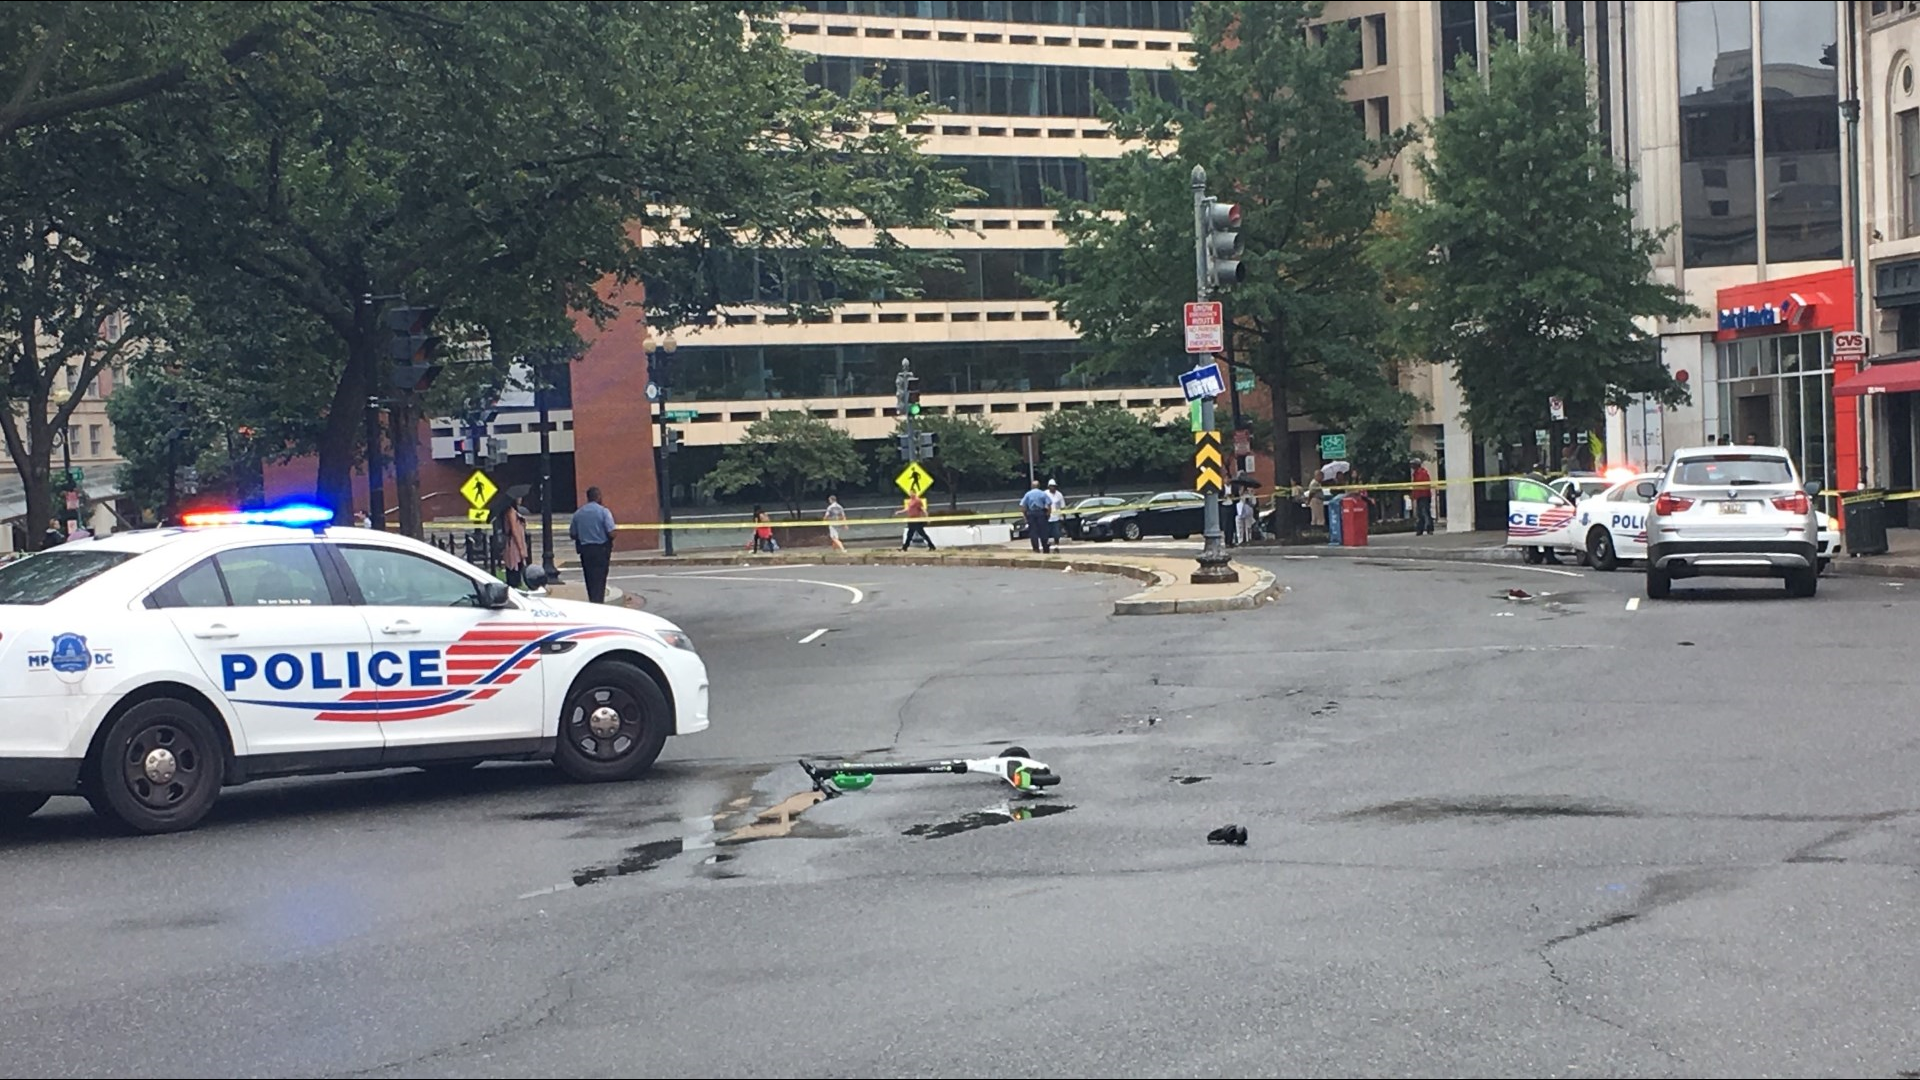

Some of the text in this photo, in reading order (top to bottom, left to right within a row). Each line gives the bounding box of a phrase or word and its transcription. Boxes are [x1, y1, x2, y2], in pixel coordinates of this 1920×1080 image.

[1836, 335, 1863, 347] CVS
[1612, 515, 1648, 529] POLI
[28, 655, 49, 667] MP
[94, 653, 113, 664] DC
[221, 650, 443, 692] POLICE
